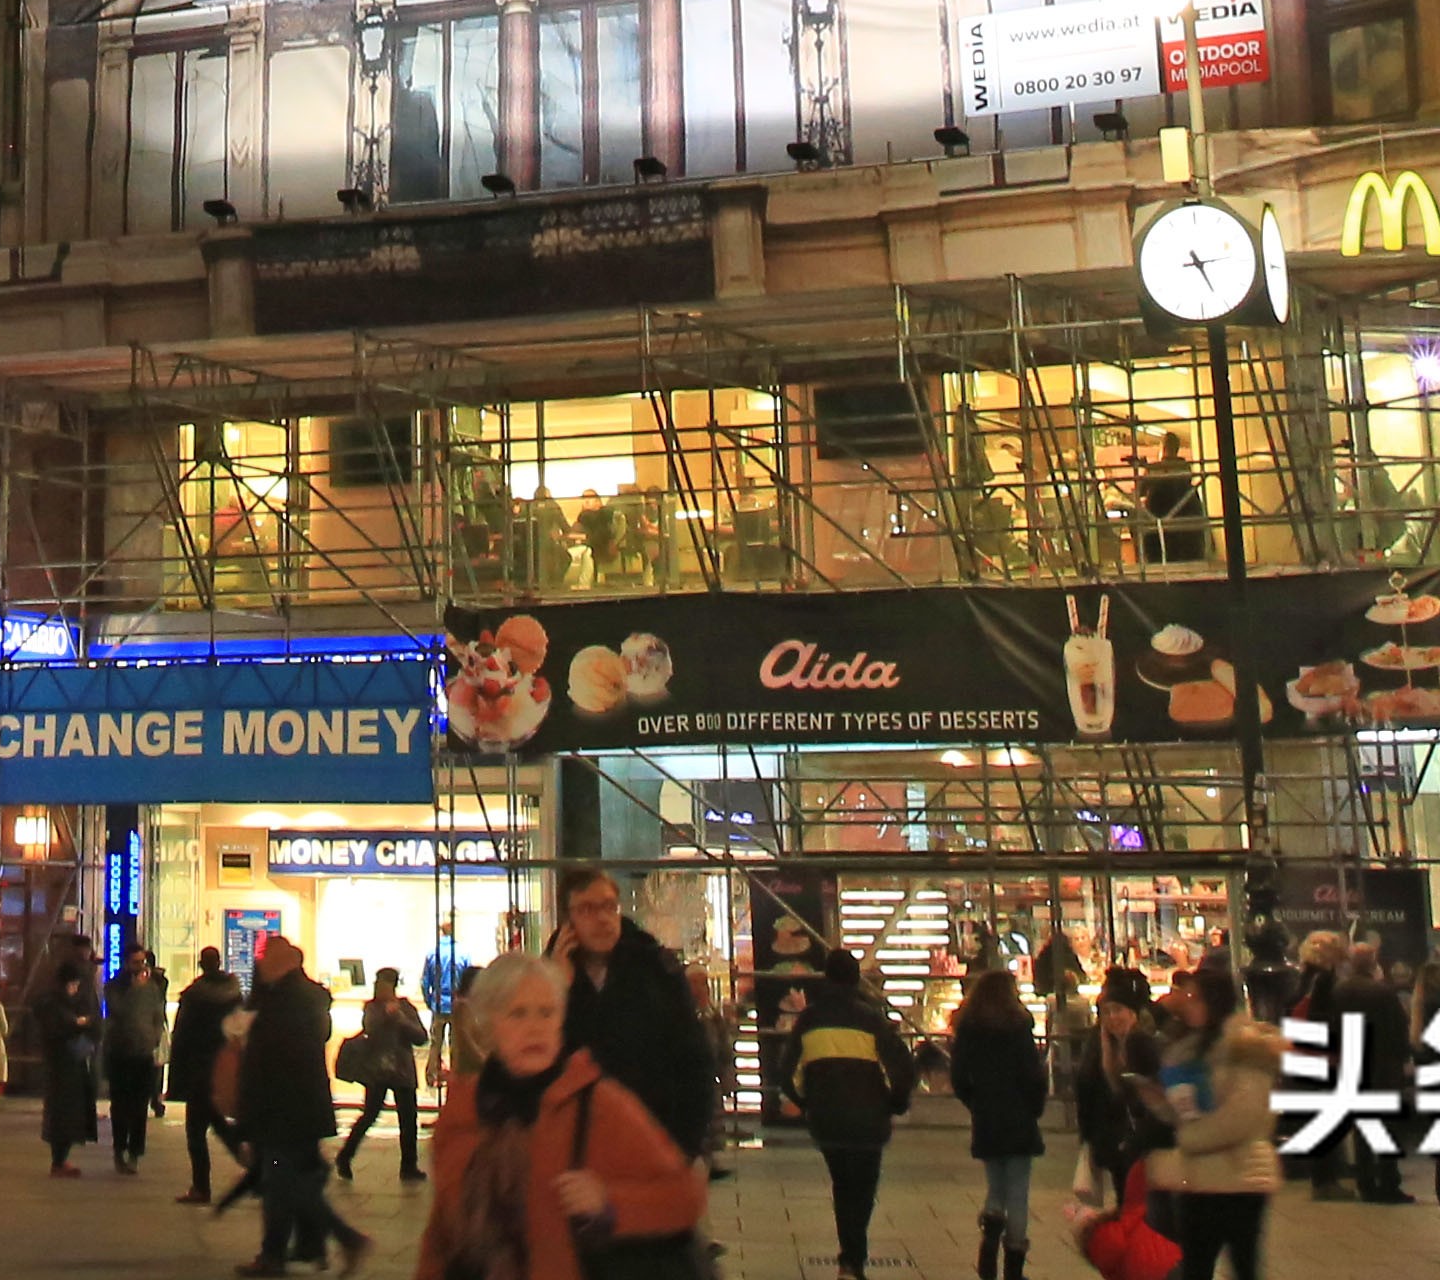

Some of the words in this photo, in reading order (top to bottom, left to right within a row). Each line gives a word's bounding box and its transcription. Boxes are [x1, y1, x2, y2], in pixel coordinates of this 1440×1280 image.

[1009, 14, 1142, 44] www.wedia.at
[1169, 41, 1261, 67] OTDOOR
[1013, 78, 1059, 97] 0800
[1064, 72, 1088, 91] 20
[1093, 70, 1116, 88] 30
[1120, 66, 1143, 83] 97
[1171, 58, 1263, 84] MDIAPOOL
[222, 707, 422, 756] MONEY
[638, 715, 690, 734] OVER
[696, 713, 721, 732] 800
[726, 711, 836, 732] DIFFERENT
[841, 711, 903, 731] TYPES
[908, 711, 933, 730] OF
[939, 710, 1040, 731] DESSERTS
[269, 838, 369, 867] MONEY
[109, 853, 121, 915] MONEY
